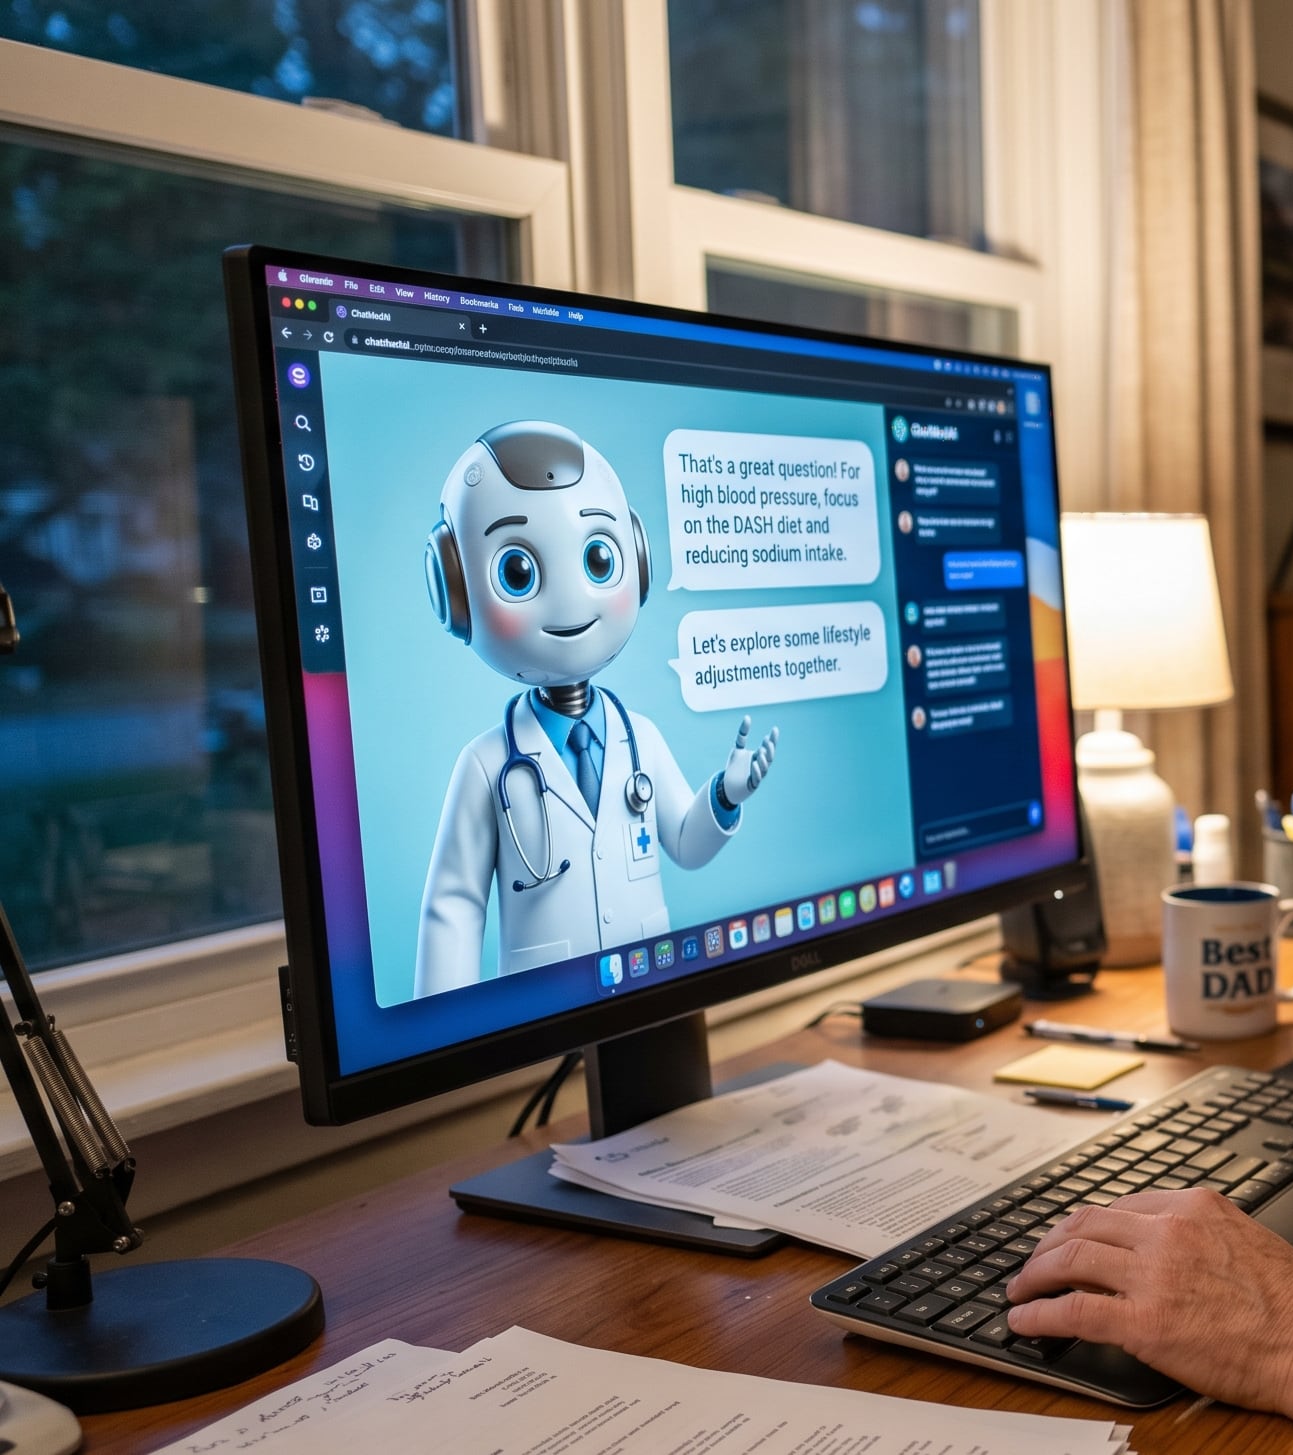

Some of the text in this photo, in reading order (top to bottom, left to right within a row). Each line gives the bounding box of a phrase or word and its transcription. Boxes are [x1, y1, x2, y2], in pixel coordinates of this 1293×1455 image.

[395, 287, 414, 299] View
[678, 453, 861, 481] That's a great question! For
[681, 484, 859, 509] high blood pressure, focus
[684, 515, 830, 534] on the DASH diet and
[686, 543, 847, 568] reducing sodium intake.
[693, 624, 871, 656] Let's explore some lifestyle
[695, 655, 841, 689] adjustments together.
[1202, 935, 1273, 967] Best
[1202, 967, 1275, 999] DAD
